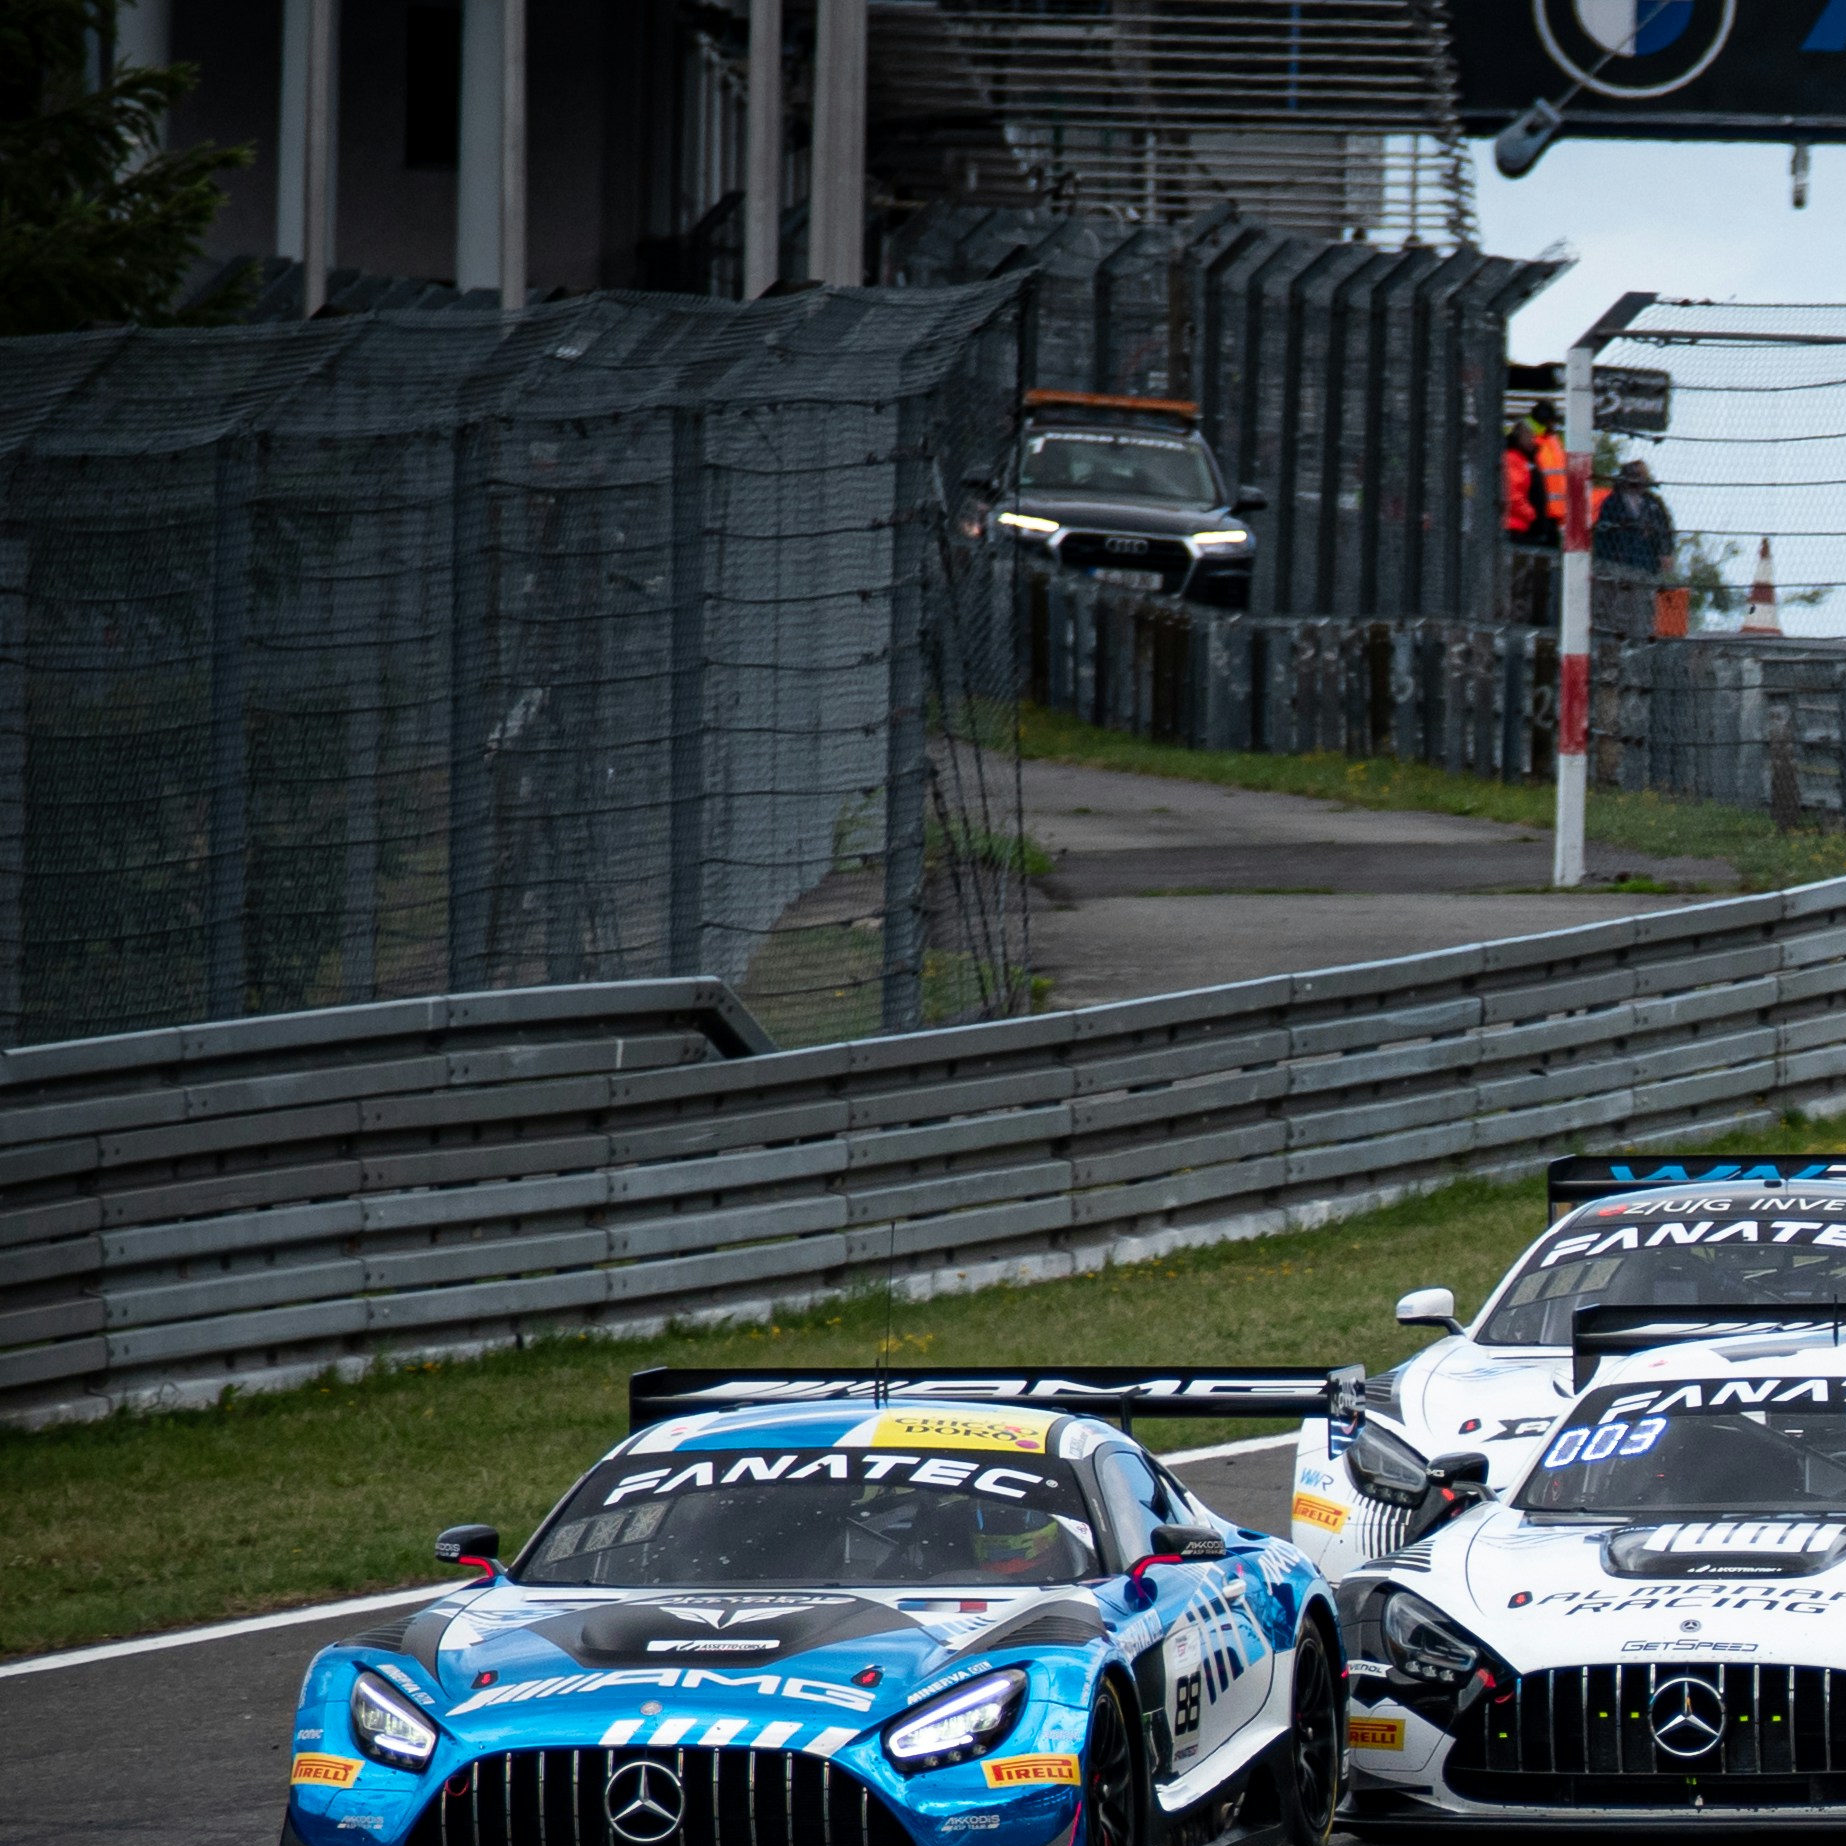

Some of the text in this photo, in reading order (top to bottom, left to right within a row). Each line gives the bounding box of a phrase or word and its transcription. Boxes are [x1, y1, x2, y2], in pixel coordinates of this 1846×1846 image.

[1544, 1414, 1667, 1468] 003
[604, 1453, 1043, 1506] FANATEC
[1293, 1496, 1344, 1528] PIRELLI
[1565, 1596, 1827, 1616] RACING
[1348, 1663, 1383, 1674] VENOL
[579, 1668, 876, 1713] AMG
[907, 1670, 970, 1706] MINERVA
[1175, 1670, 1201, 1737] 88
[1349, 1722, 1398, 1744] RELLI
[293, 1758, 355, 1782] PIRELLI
[991, 1759, 1075, 1782] PIRELLI
[945, 1814, 1001, 1825] AKKODIS
